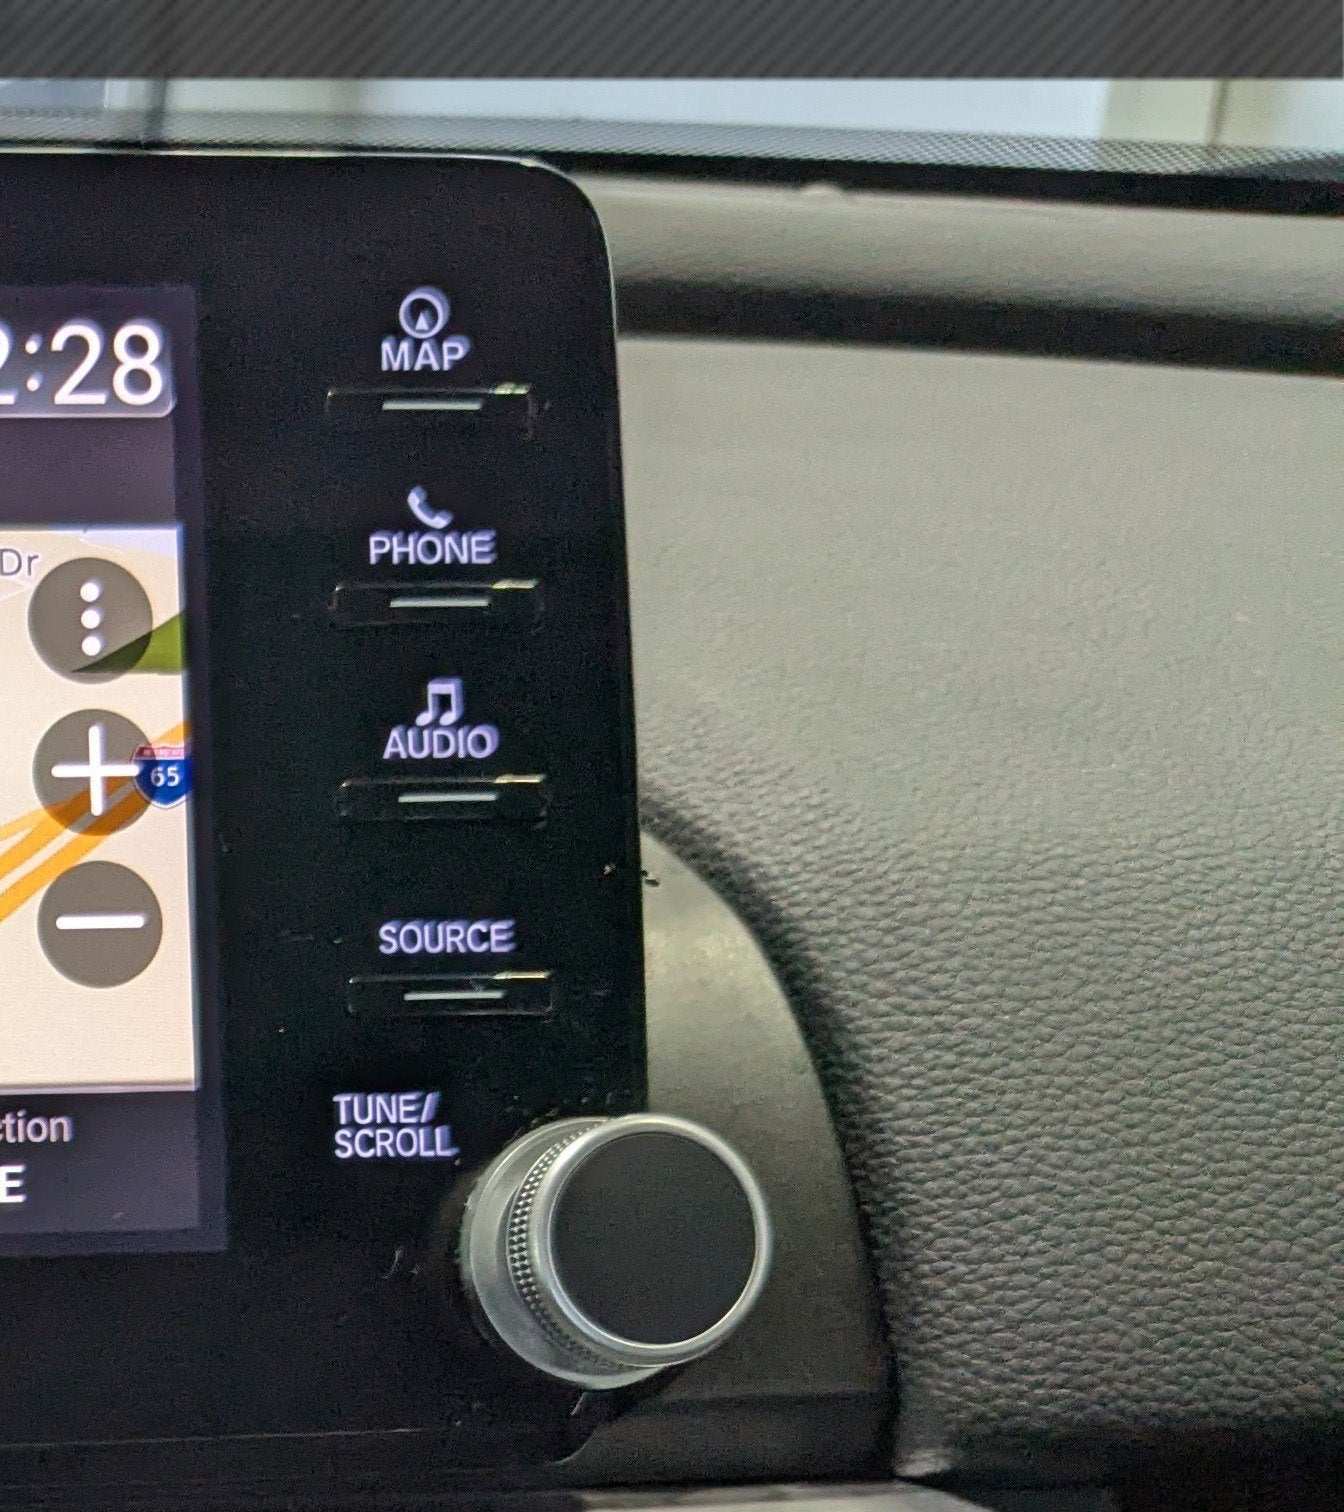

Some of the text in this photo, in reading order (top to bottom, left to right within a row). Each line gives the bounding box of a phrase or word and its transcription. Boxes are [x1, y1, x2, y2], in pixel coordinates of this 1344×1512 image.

[381, 336, 471, 371] MAP
[369, 530, 497, 564] PHONE
[383, 725, 499, 759] AUDIO
[151, 766, 180, 787] 65
[379, 919, 516, 955] SOURCE
[332, 1091, 440, 1125] TUNE/
[334, 1126, 459, 1159] SCROLL
